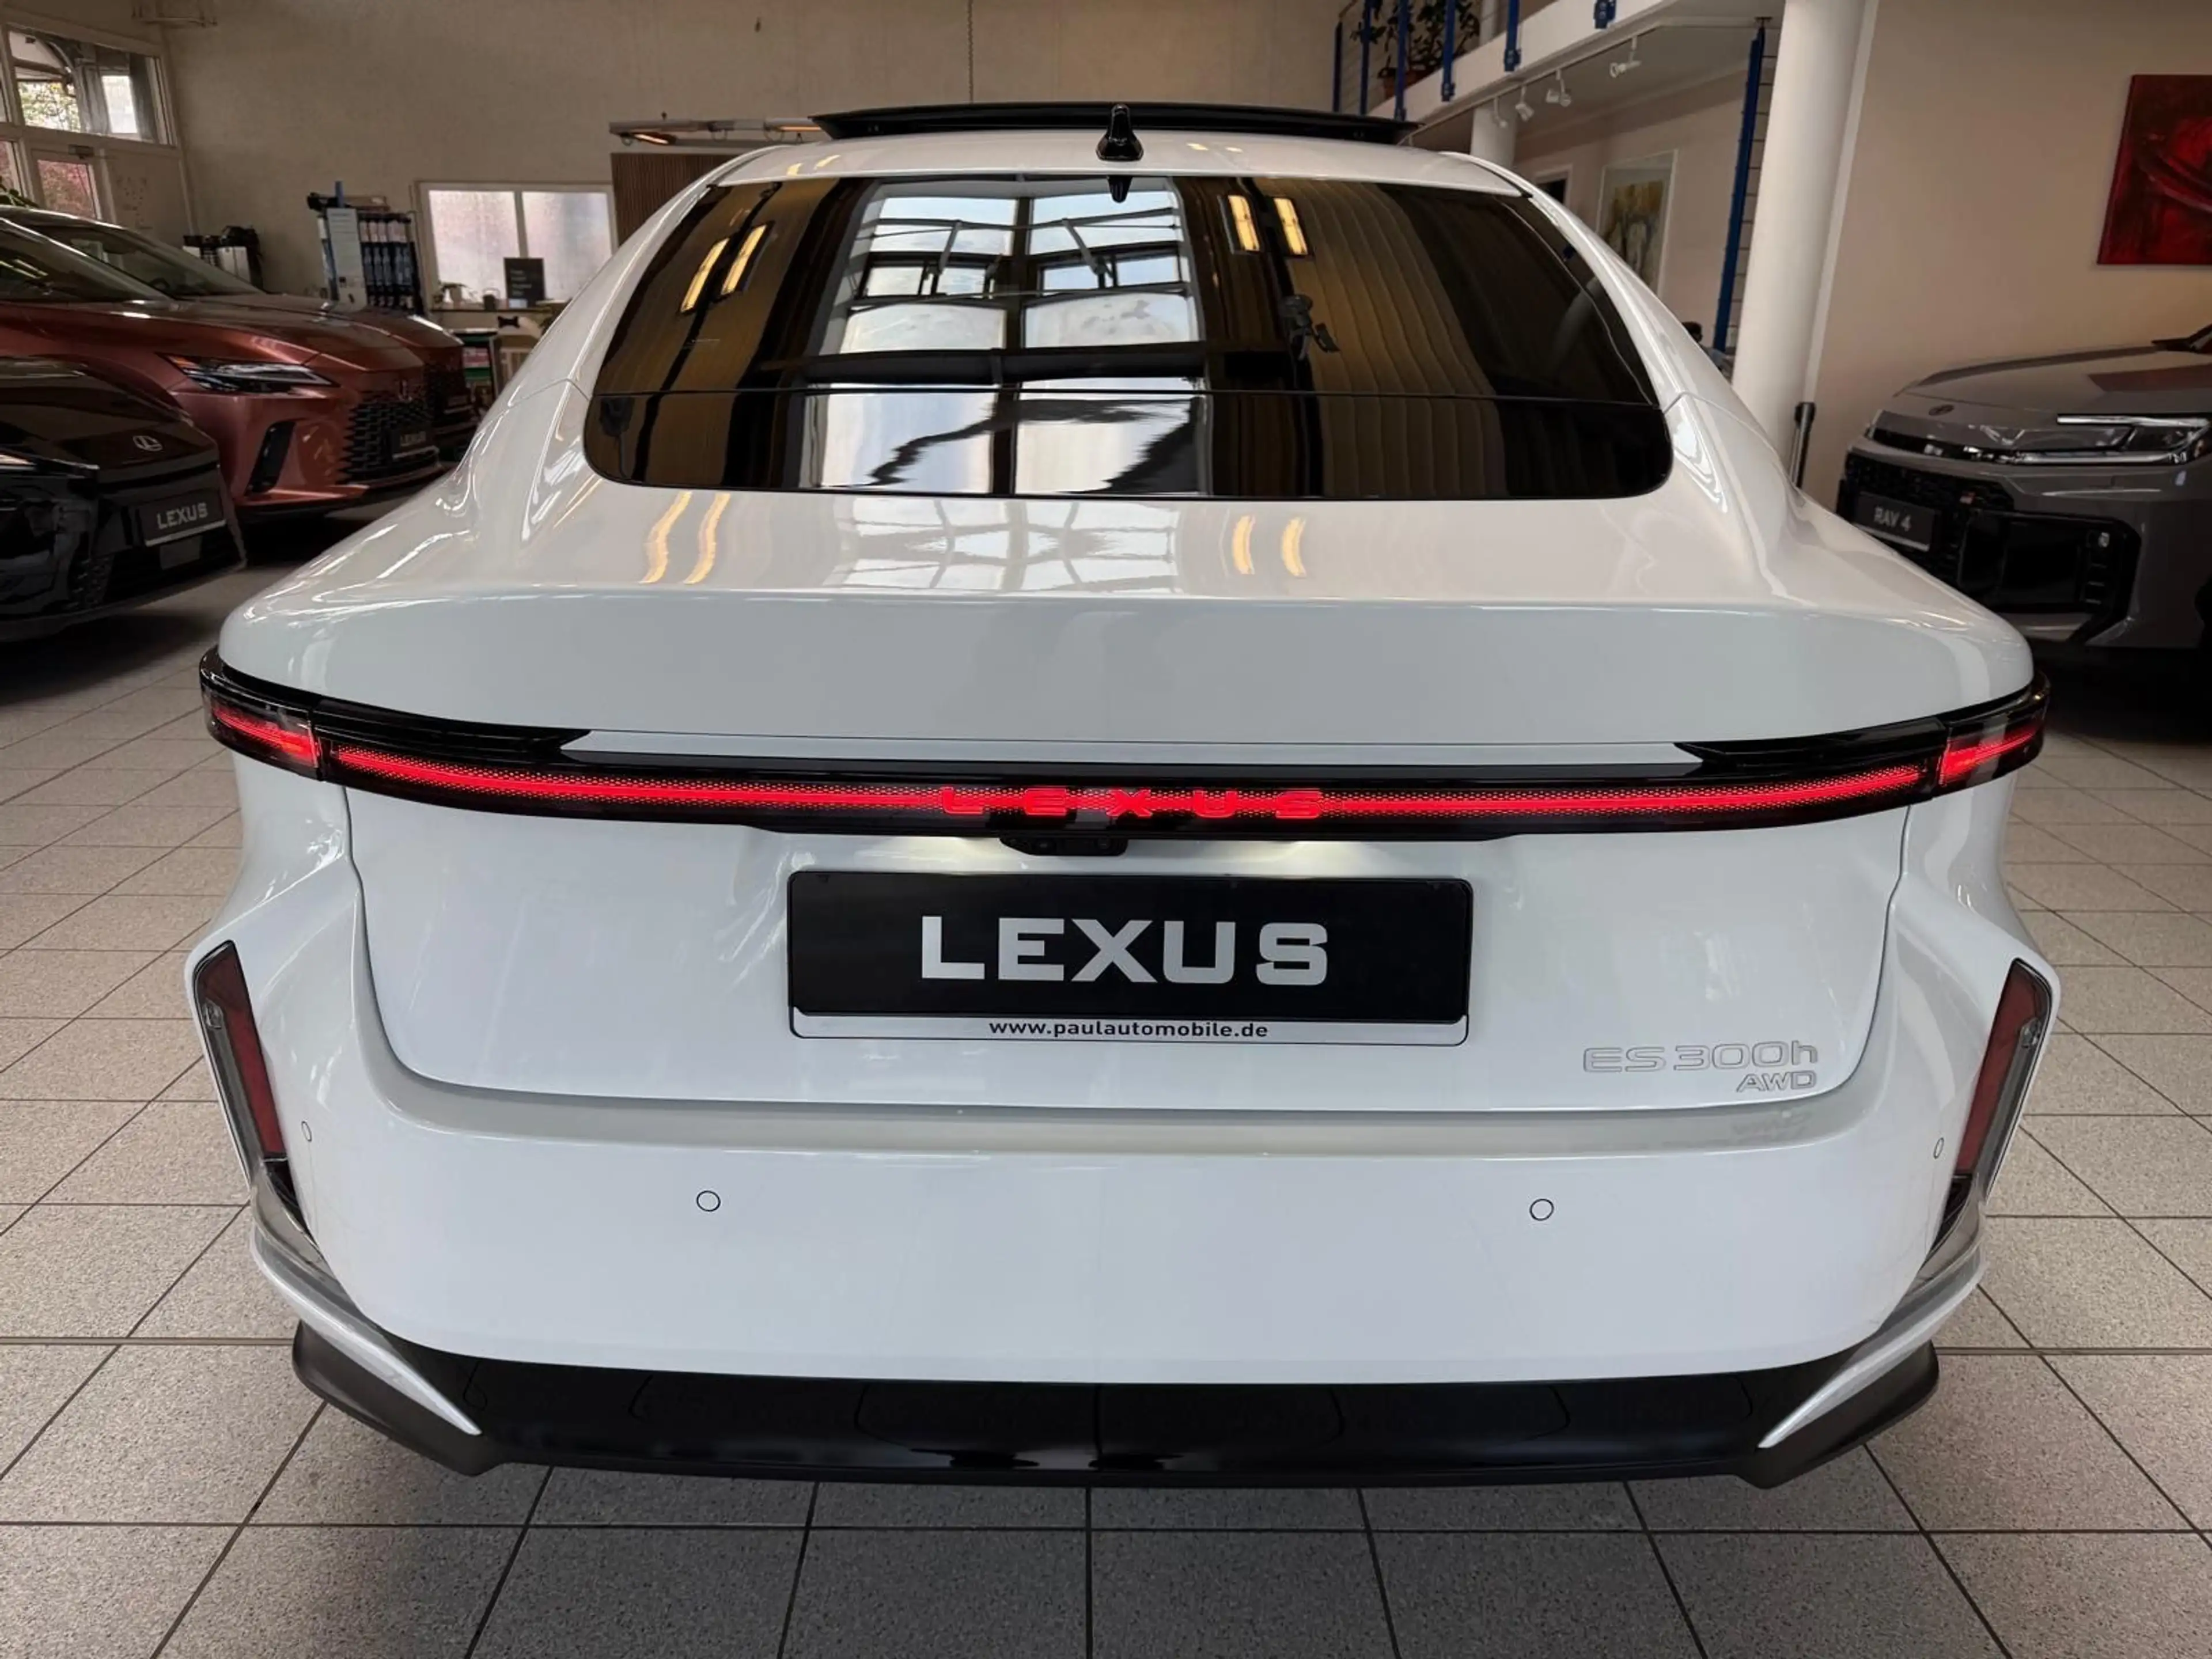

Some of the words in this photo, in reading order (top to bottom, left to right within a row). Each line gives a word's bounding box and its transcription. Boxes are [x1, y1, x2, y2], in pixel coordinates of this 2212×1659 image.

[157, 502, 209, 529] LEXUS
[1873, 505, 1900, 528] RAV
[1900, 514, 1912, 532] 4
[941, 786, 1323, 819] LEXUS
[921, 915, 1329, 986] LEXUS
[989, 1018, 1268, 1039] www.paulautomobile.de
[1582, 1046, 1666, 1073] ES
[1673, 1040, 1819, 1071] 300h
[1736, 1070, 1817, 1093] AWD
